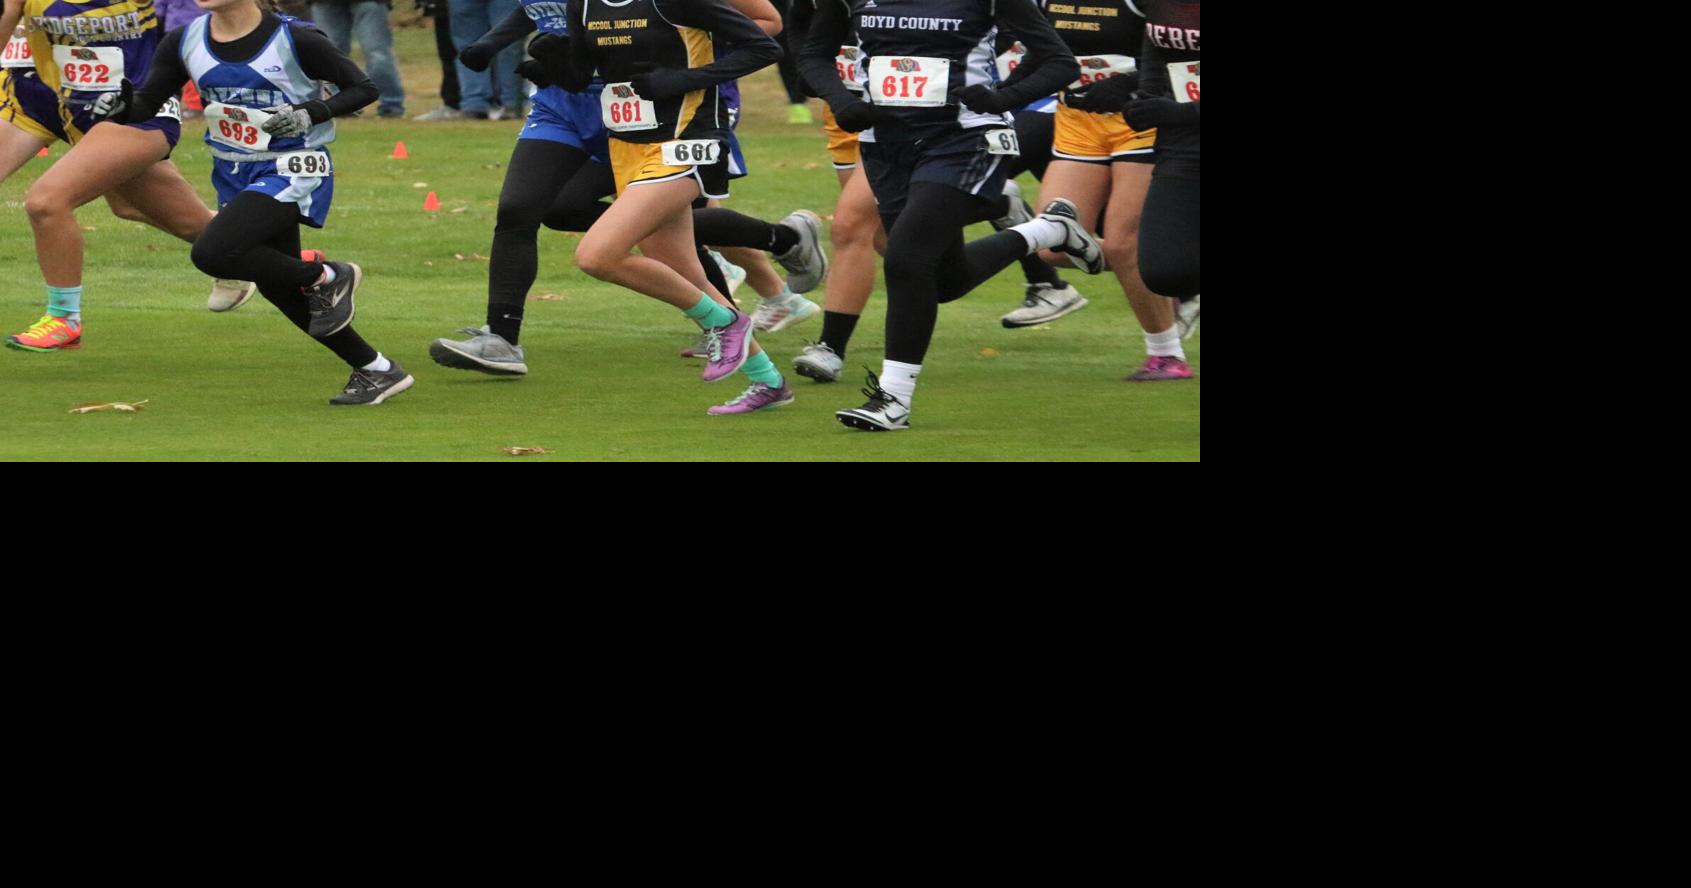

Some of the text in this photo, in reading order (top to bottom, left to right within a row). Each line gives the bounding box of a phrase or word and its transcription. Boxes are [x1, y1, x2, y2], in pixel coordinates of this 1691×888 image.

[29, 11, 140, 34] IDGEPORT
[588, 19, 647, 30] MCCOOL JUNCTION
[861, 15, 963, 31] BOYD COUNTY
[598, 36, 632, 46] MUSTANGS
[5, 42, 31, 59] 619
[64, 63, 110, 83] 622
[882, 76, 928, 97] 617
[610, 101, 642, 123] 661
[218, 119, 258, 145] 693
[675, 143, 712, 161] 661
[288, 155, 329, 173] 693
